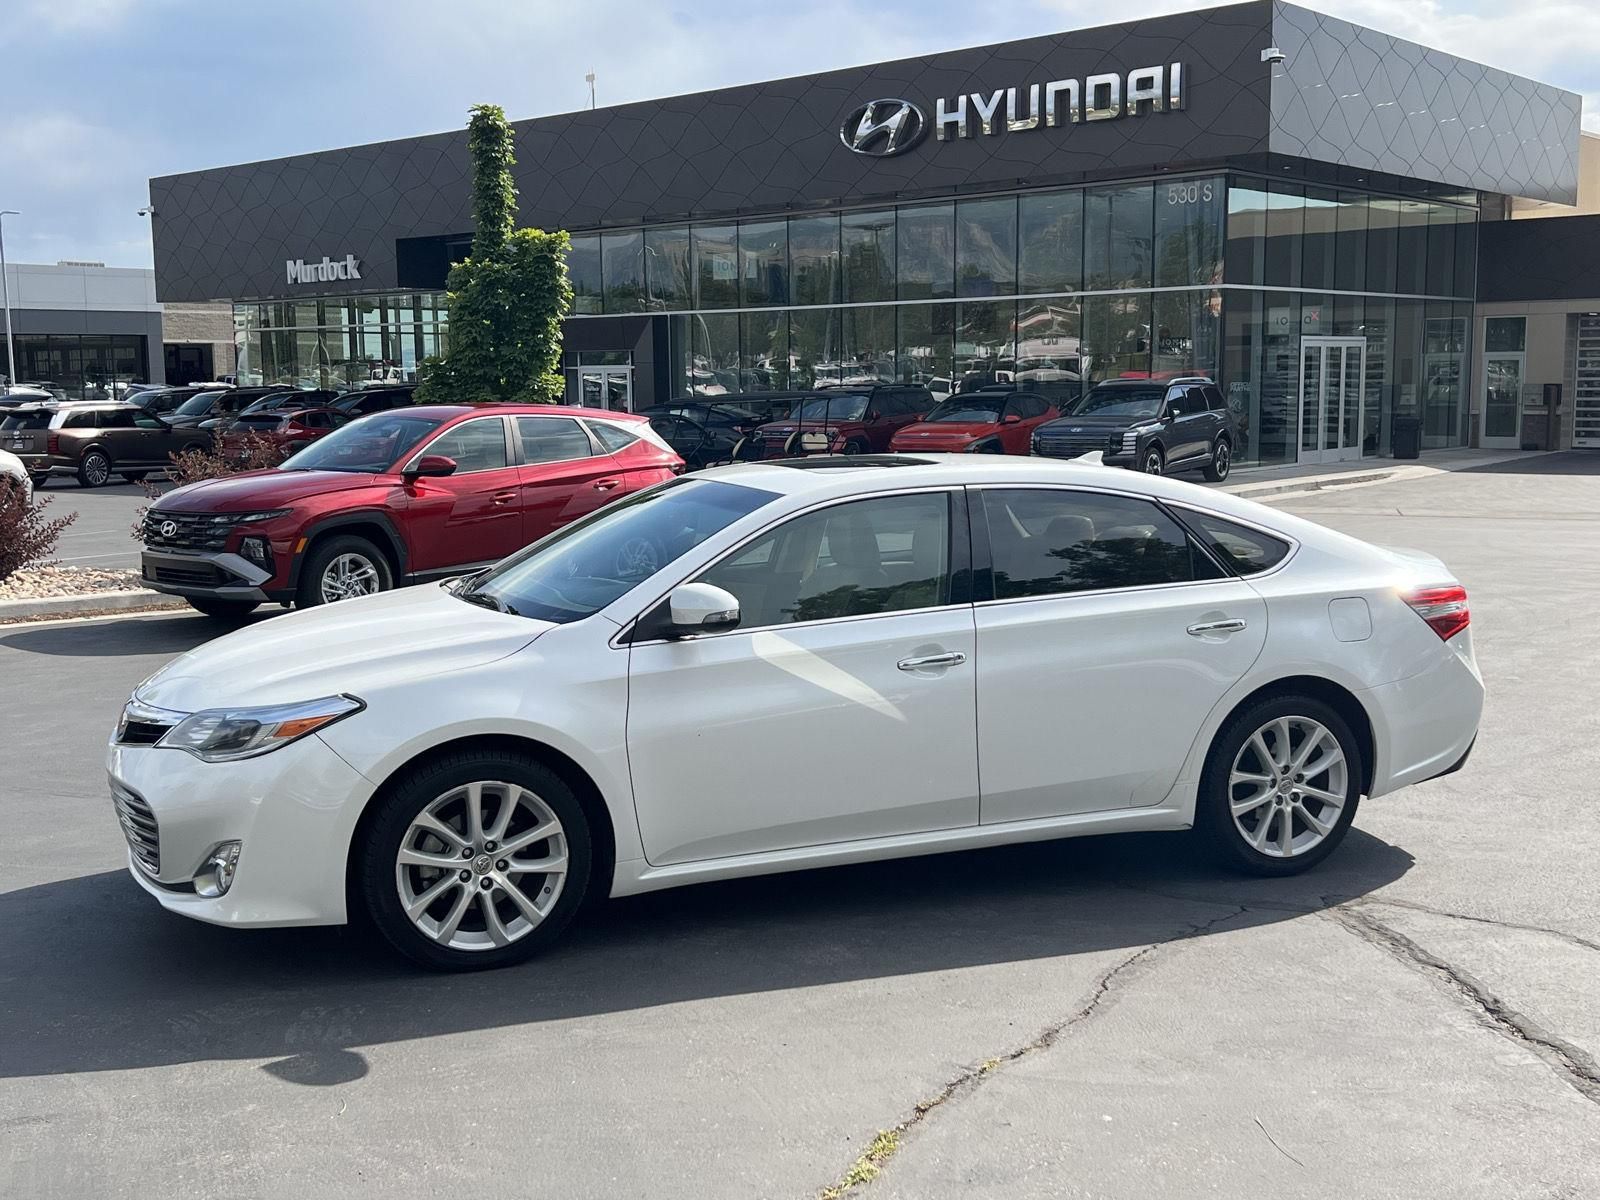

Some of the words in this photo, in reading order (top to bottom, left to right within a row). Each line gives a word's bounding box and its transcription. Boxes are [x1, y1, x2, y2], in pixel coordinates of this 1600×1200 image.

[935, 62, 1184, 141] HYUNDAI
[1168, 185, 1198, 205] 530
[1202, 184, 1213, 202] S
[286, 254, 362, 285] Murdock
